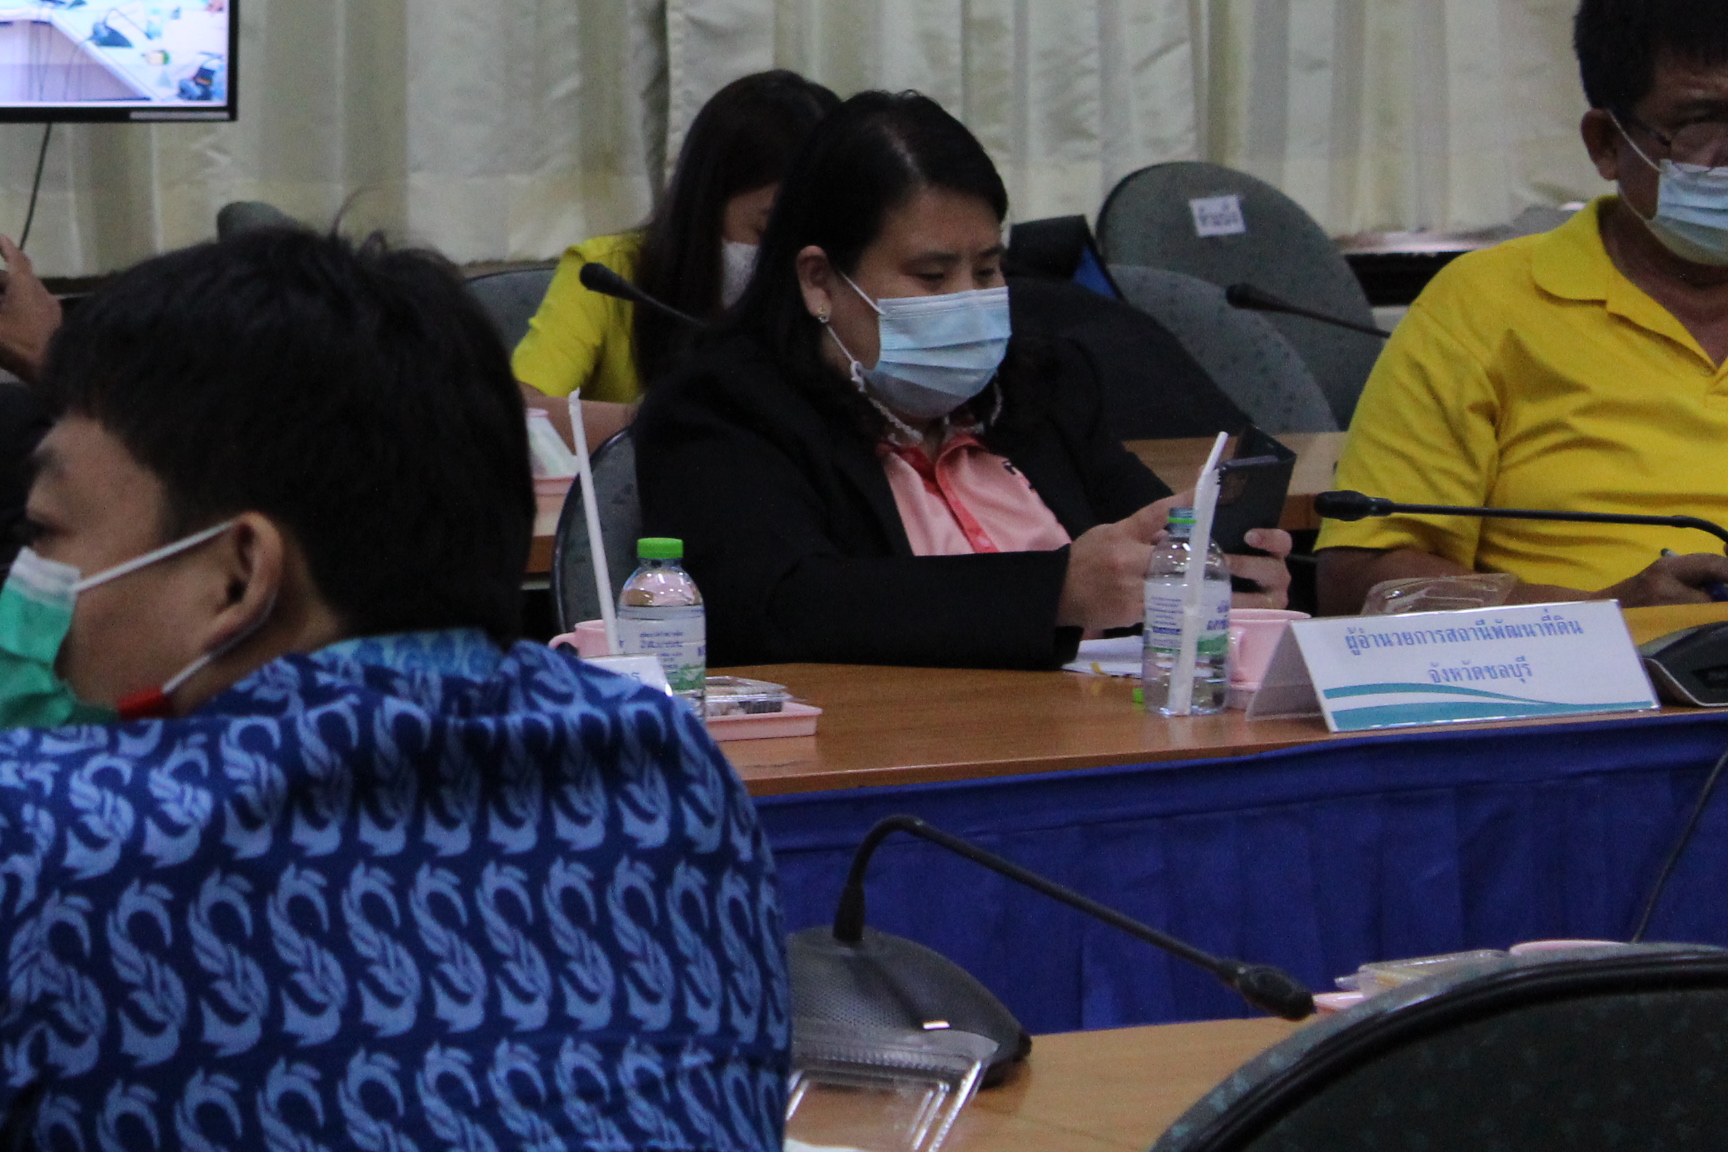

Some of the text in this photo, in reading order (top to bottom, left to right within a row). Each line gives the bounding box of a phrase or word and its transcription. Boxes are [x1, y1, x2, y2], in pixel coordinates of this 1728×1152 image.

[1427, 655, 1533, 684] จังหวัดชลบุรี
